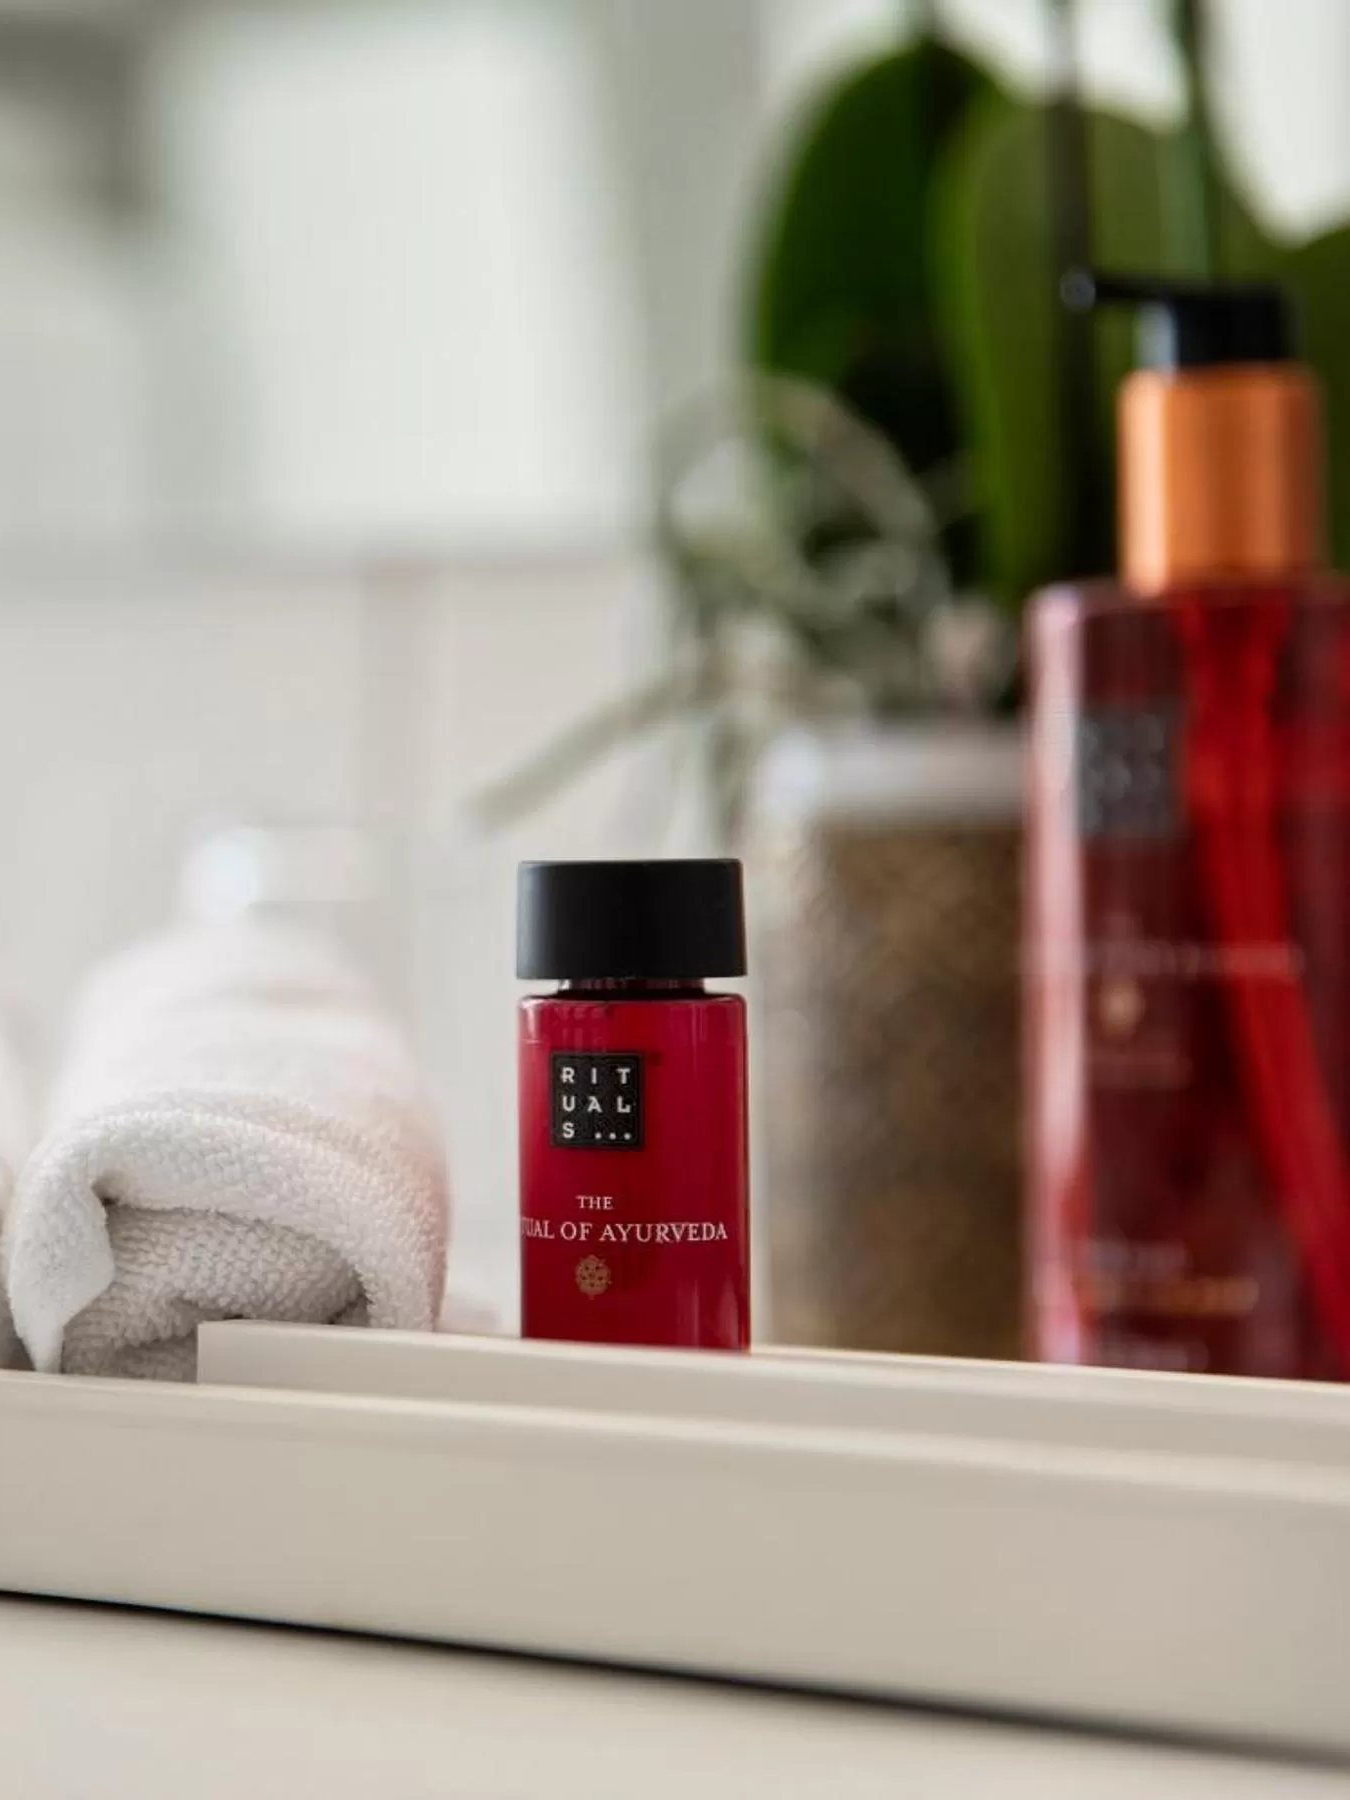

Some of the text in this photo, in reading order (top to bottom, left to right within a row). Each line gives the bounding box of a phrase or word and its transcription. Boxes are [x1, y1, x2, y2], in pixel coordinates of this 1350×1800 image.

[576, 1195, 613, 1210] THE
[560, 1221, 593, 1241] OF
[599, 1222, 728, 1243] AYURVEDA
